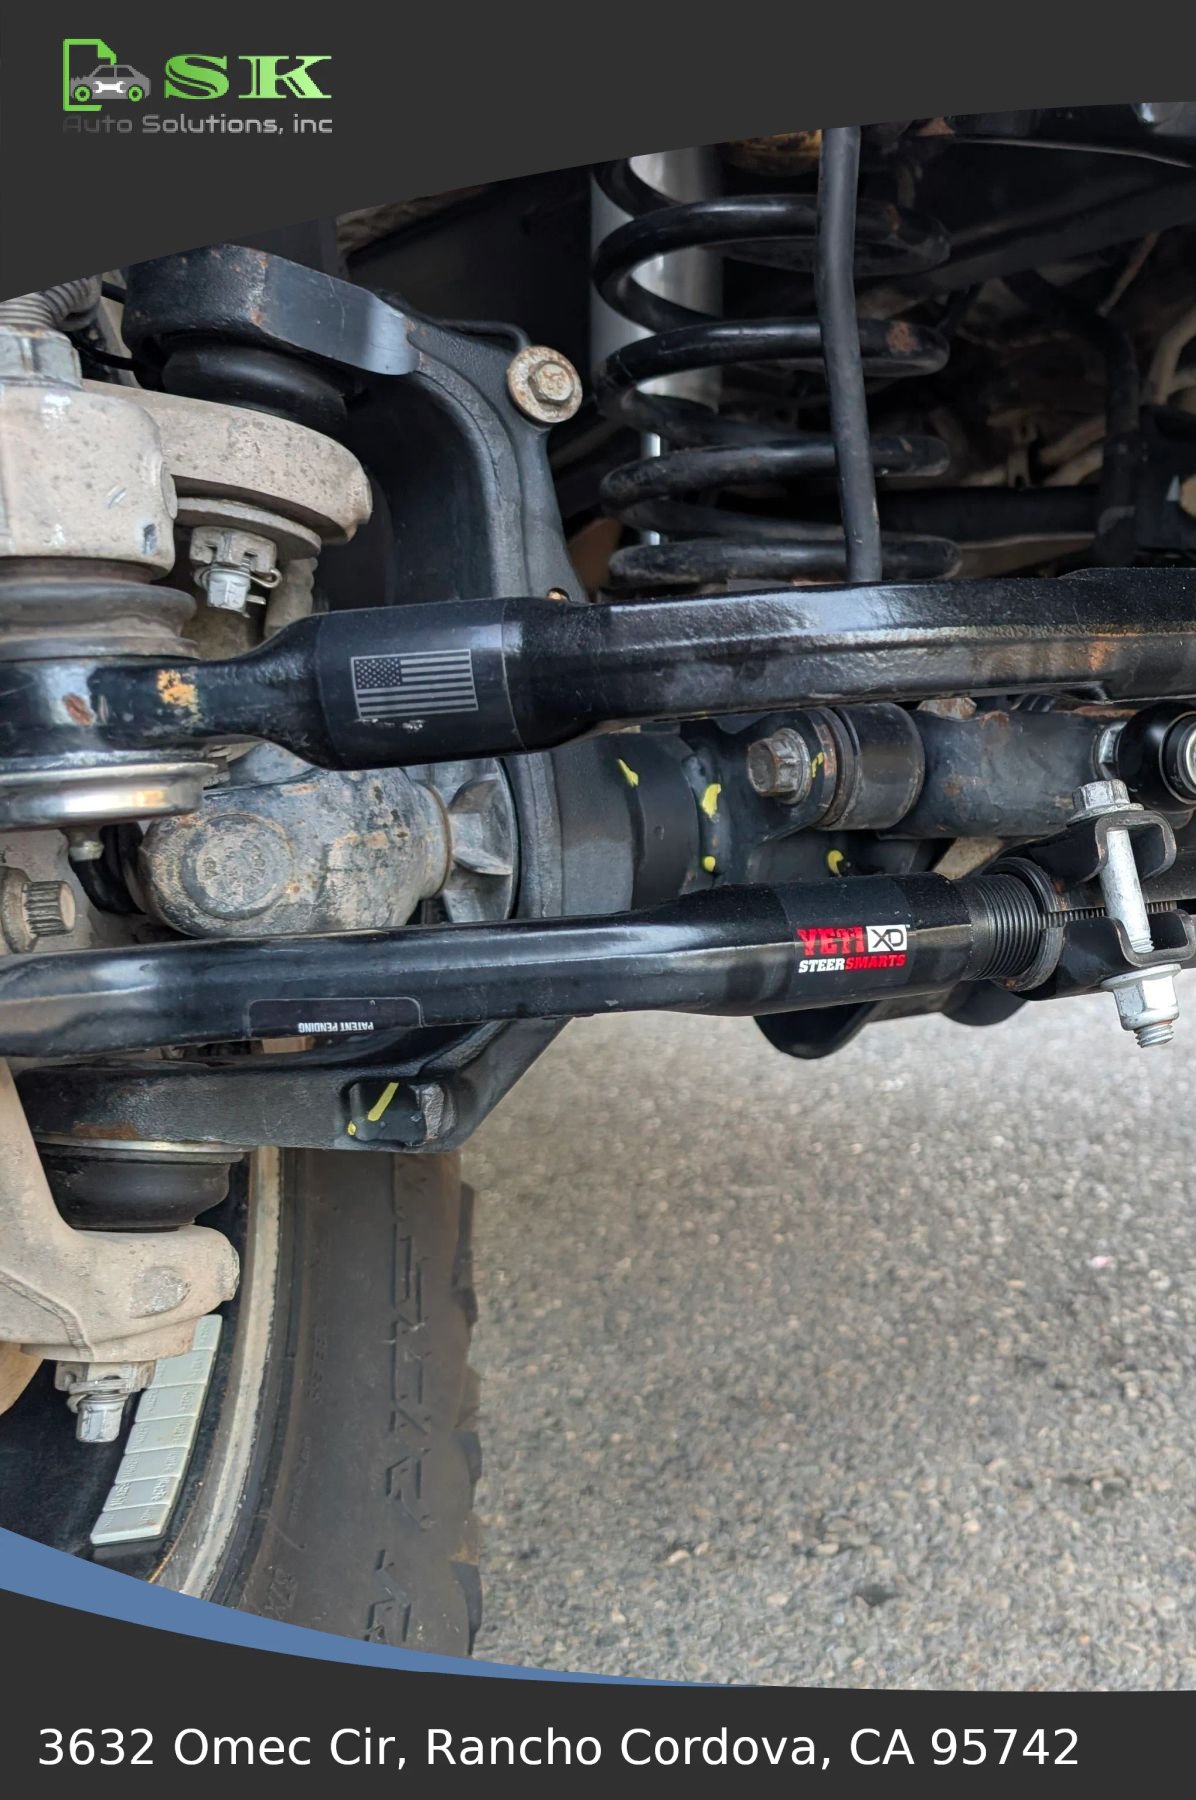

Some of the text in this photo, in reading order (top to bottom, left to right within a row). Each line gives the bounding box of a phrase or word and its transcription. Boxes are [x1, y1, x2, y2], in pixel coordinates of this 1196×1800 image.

[797, 927, 865, 956] YETI
[798, 954, 907, 974] STEERSMARTS
[297, 1021, 375, 1033] PATENT PENDING
